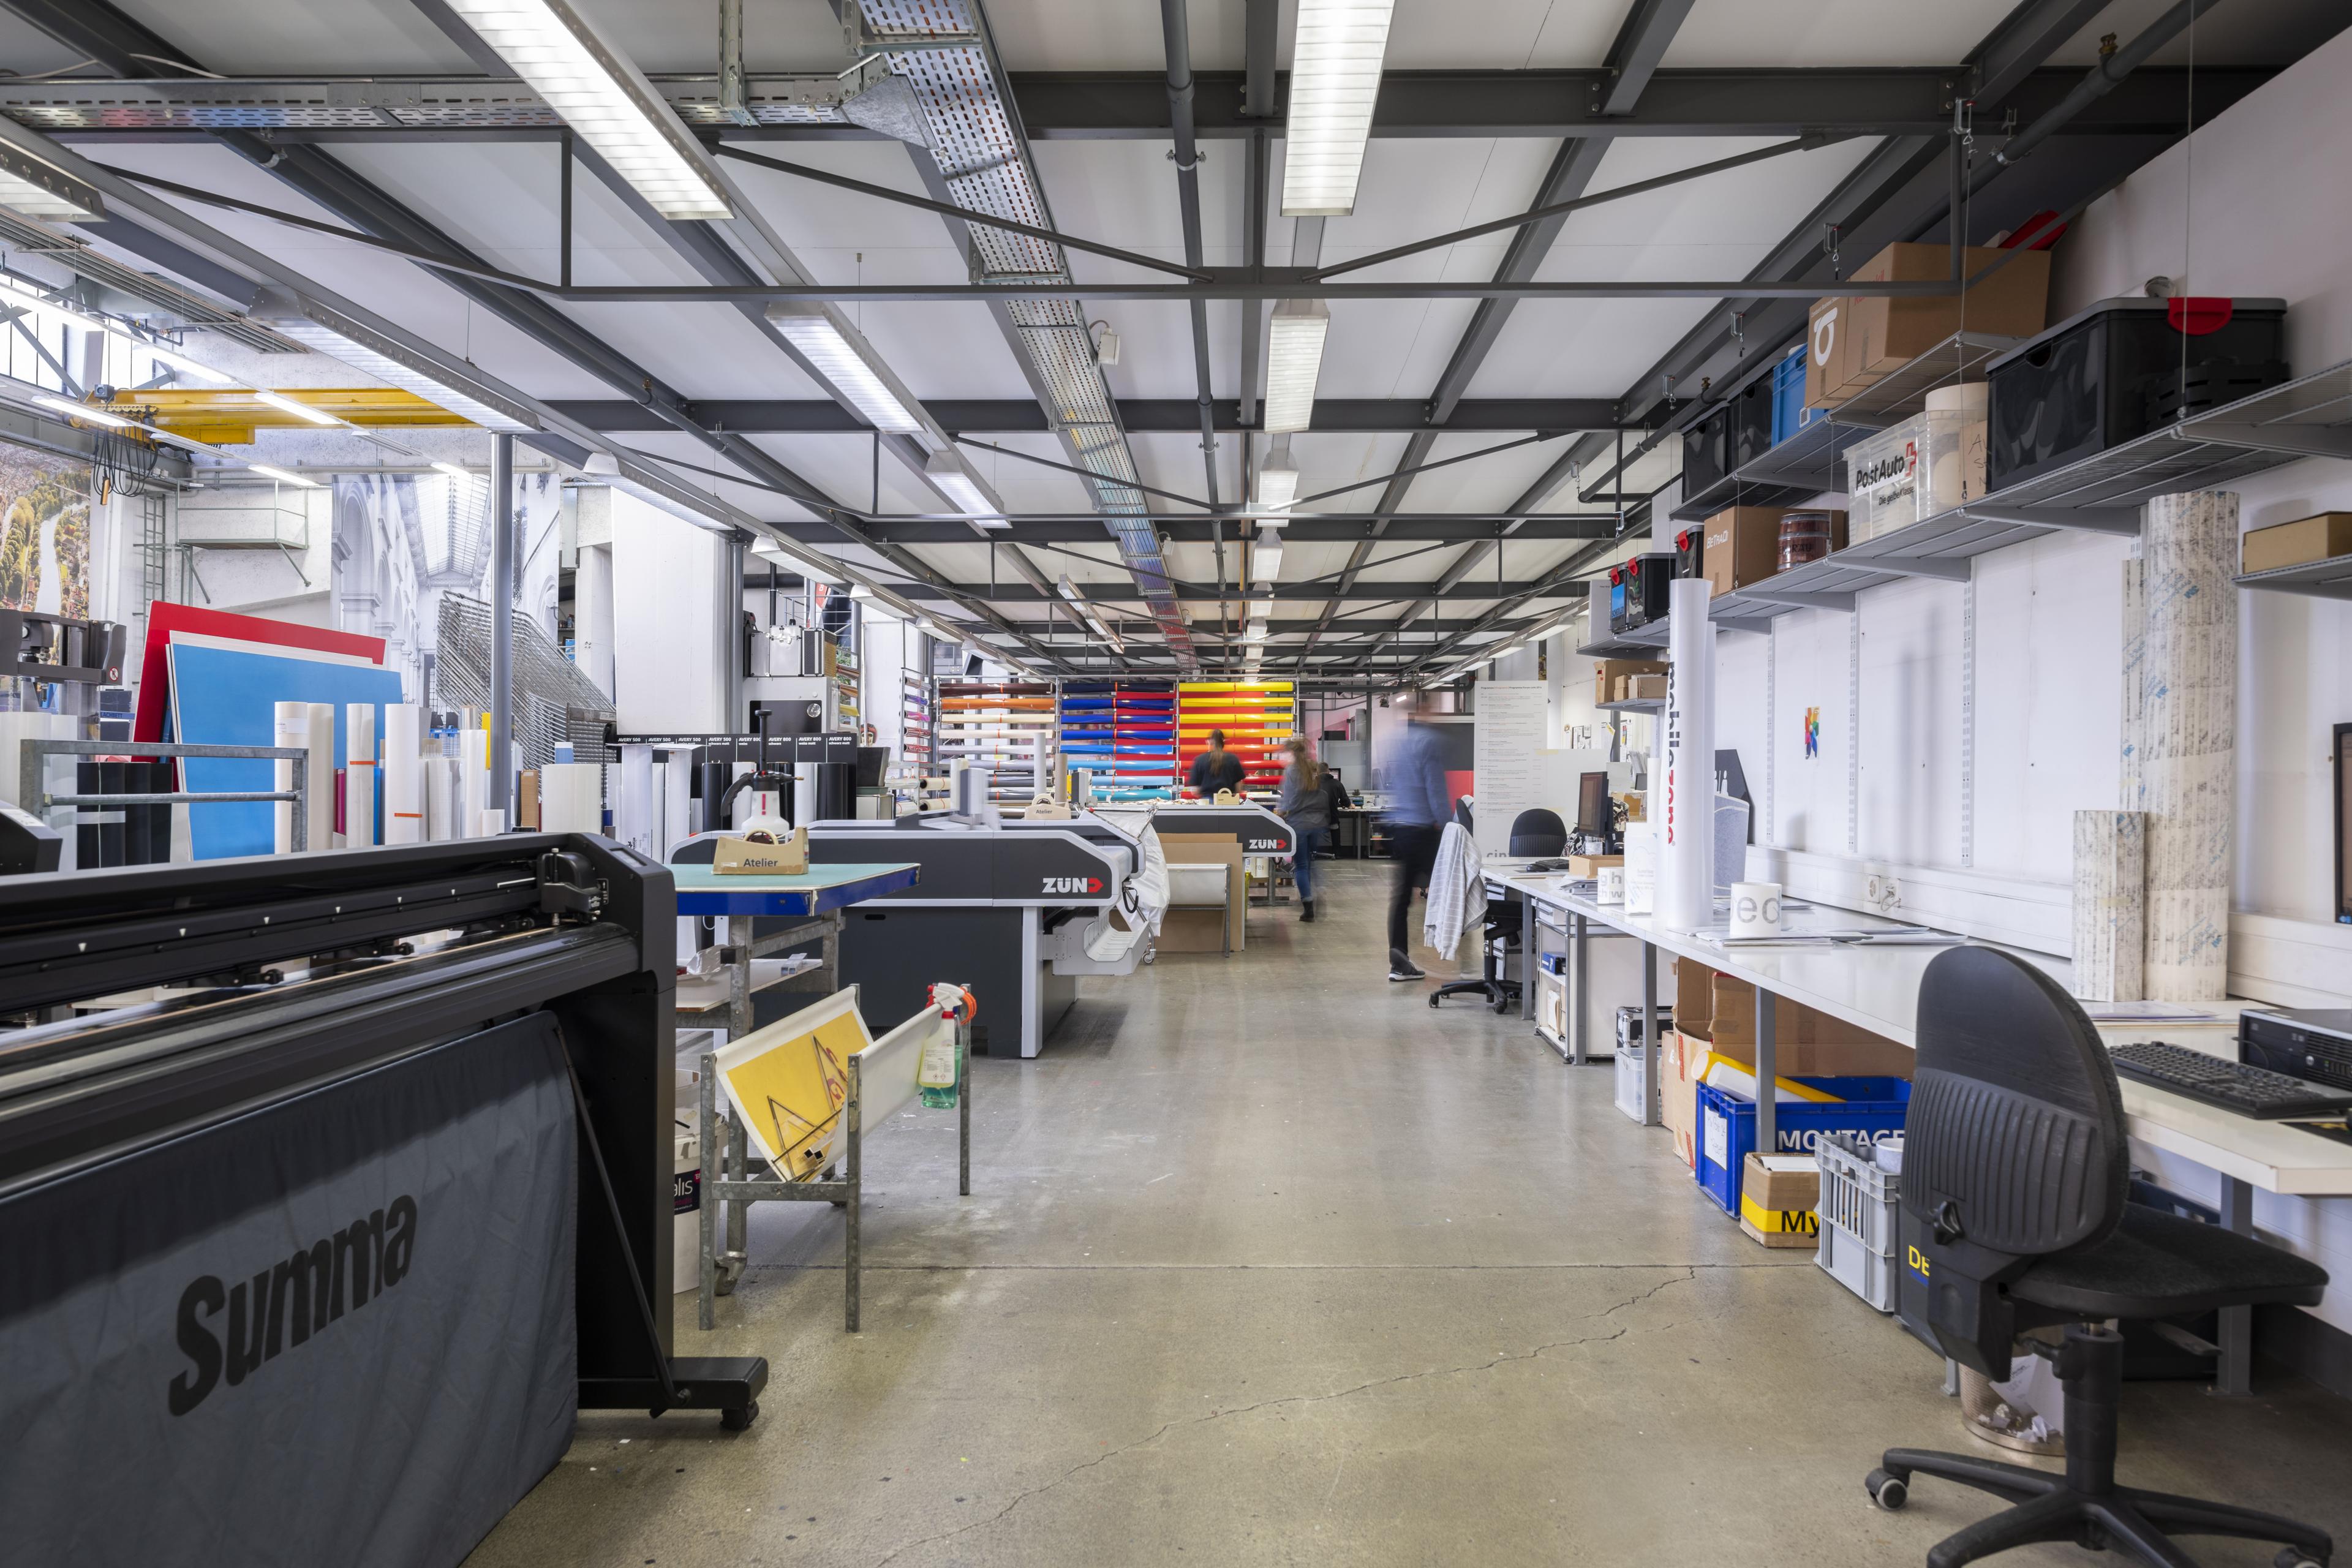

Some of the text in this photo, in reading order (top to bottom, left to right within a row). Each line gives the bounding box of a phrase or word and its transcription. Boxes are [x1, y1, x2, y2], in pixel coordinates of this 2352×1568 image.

[1856, 455, 1905, 491] PostAuto
[743, 858, 778, 867] Atelier
[168, 1195, 417, 1417] Summa
